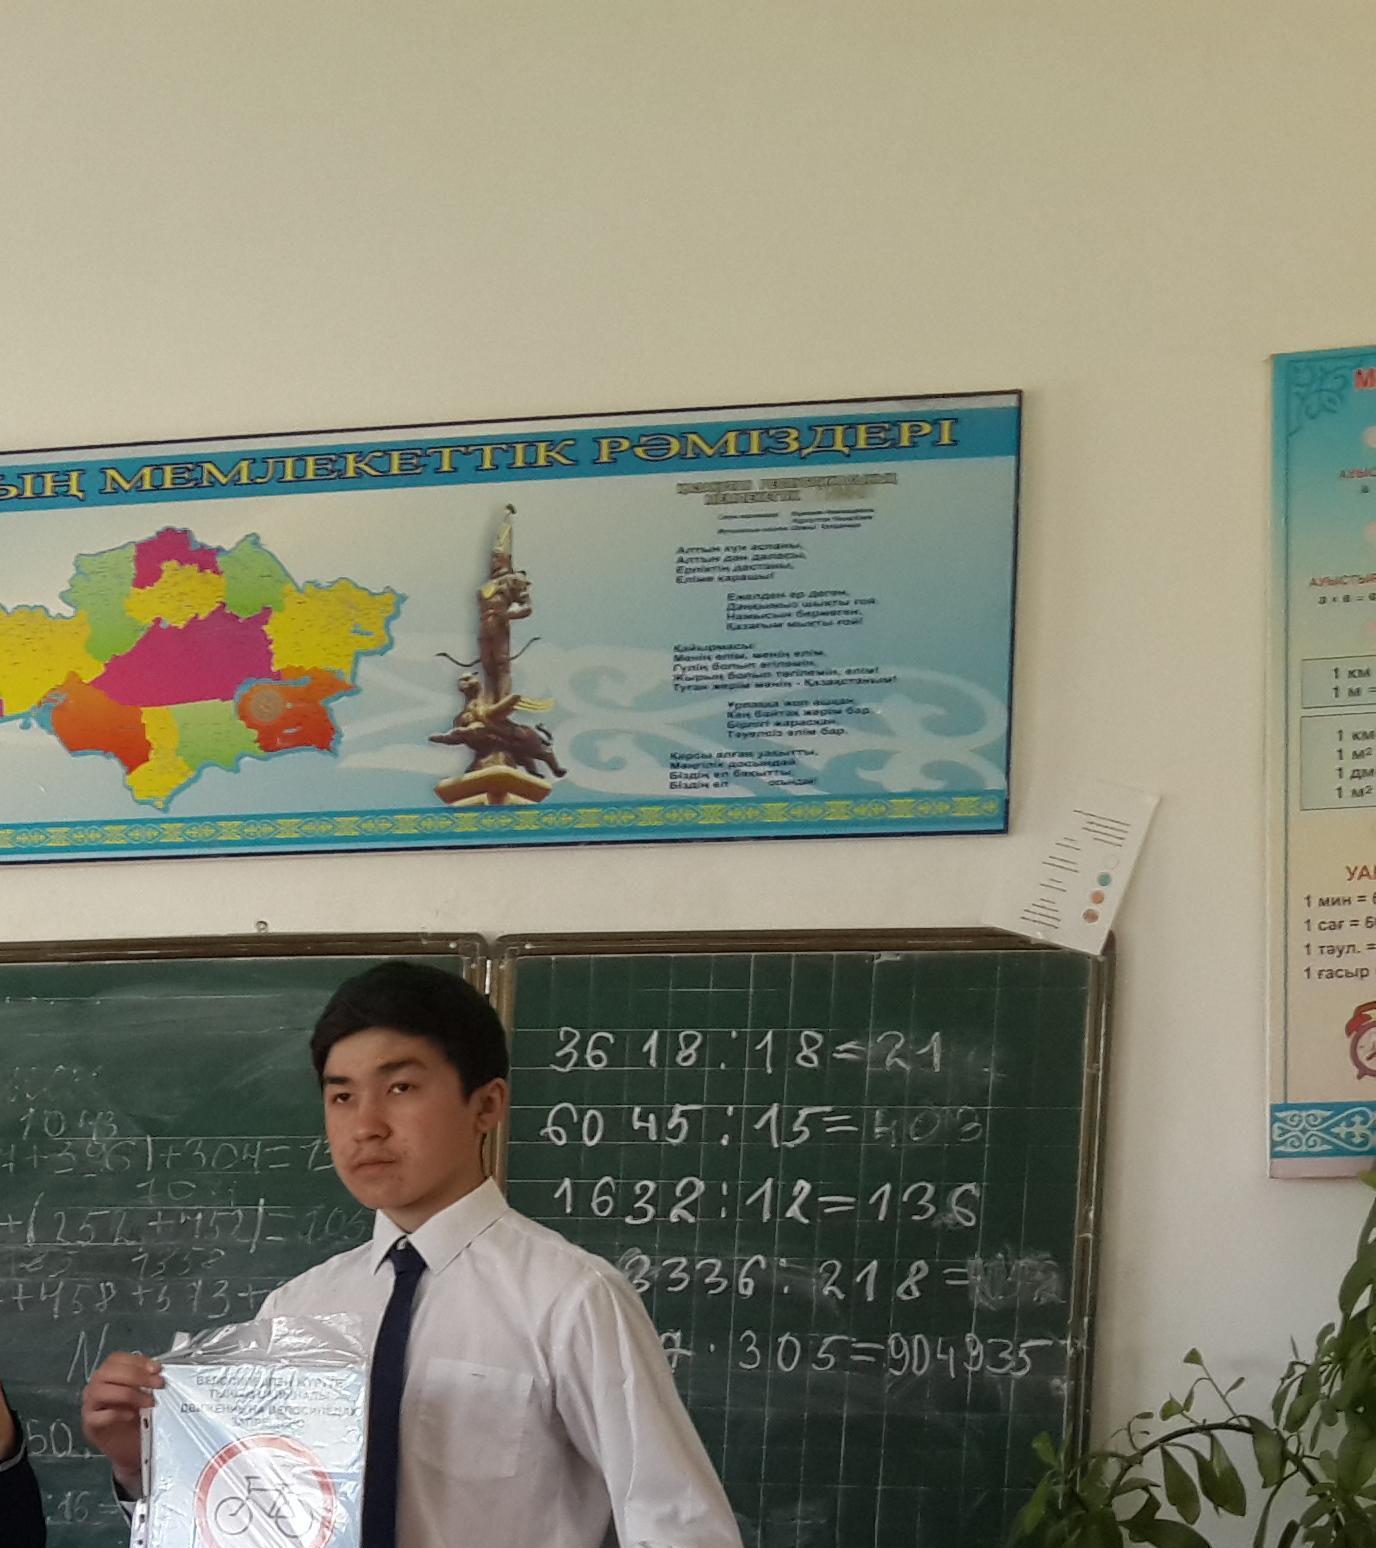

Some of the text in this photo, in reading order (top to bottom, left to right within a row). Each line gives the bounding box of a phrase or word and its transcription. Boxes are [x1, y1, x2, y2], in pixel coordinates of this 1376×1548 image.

[98, 438, 578, 495] МЕМЛЕКЕТТІК
[594, 417, 959, 465] РӘМІЗДЕРІ
[1304, 895, 1311, 907] 1
[1318, 896, 1351, 907] мин
[1304, 919, 1311, 931] 1
[1304, 944, 1311, 955] 1
[1304, 968, 1369, 983] 1 ғасыр
